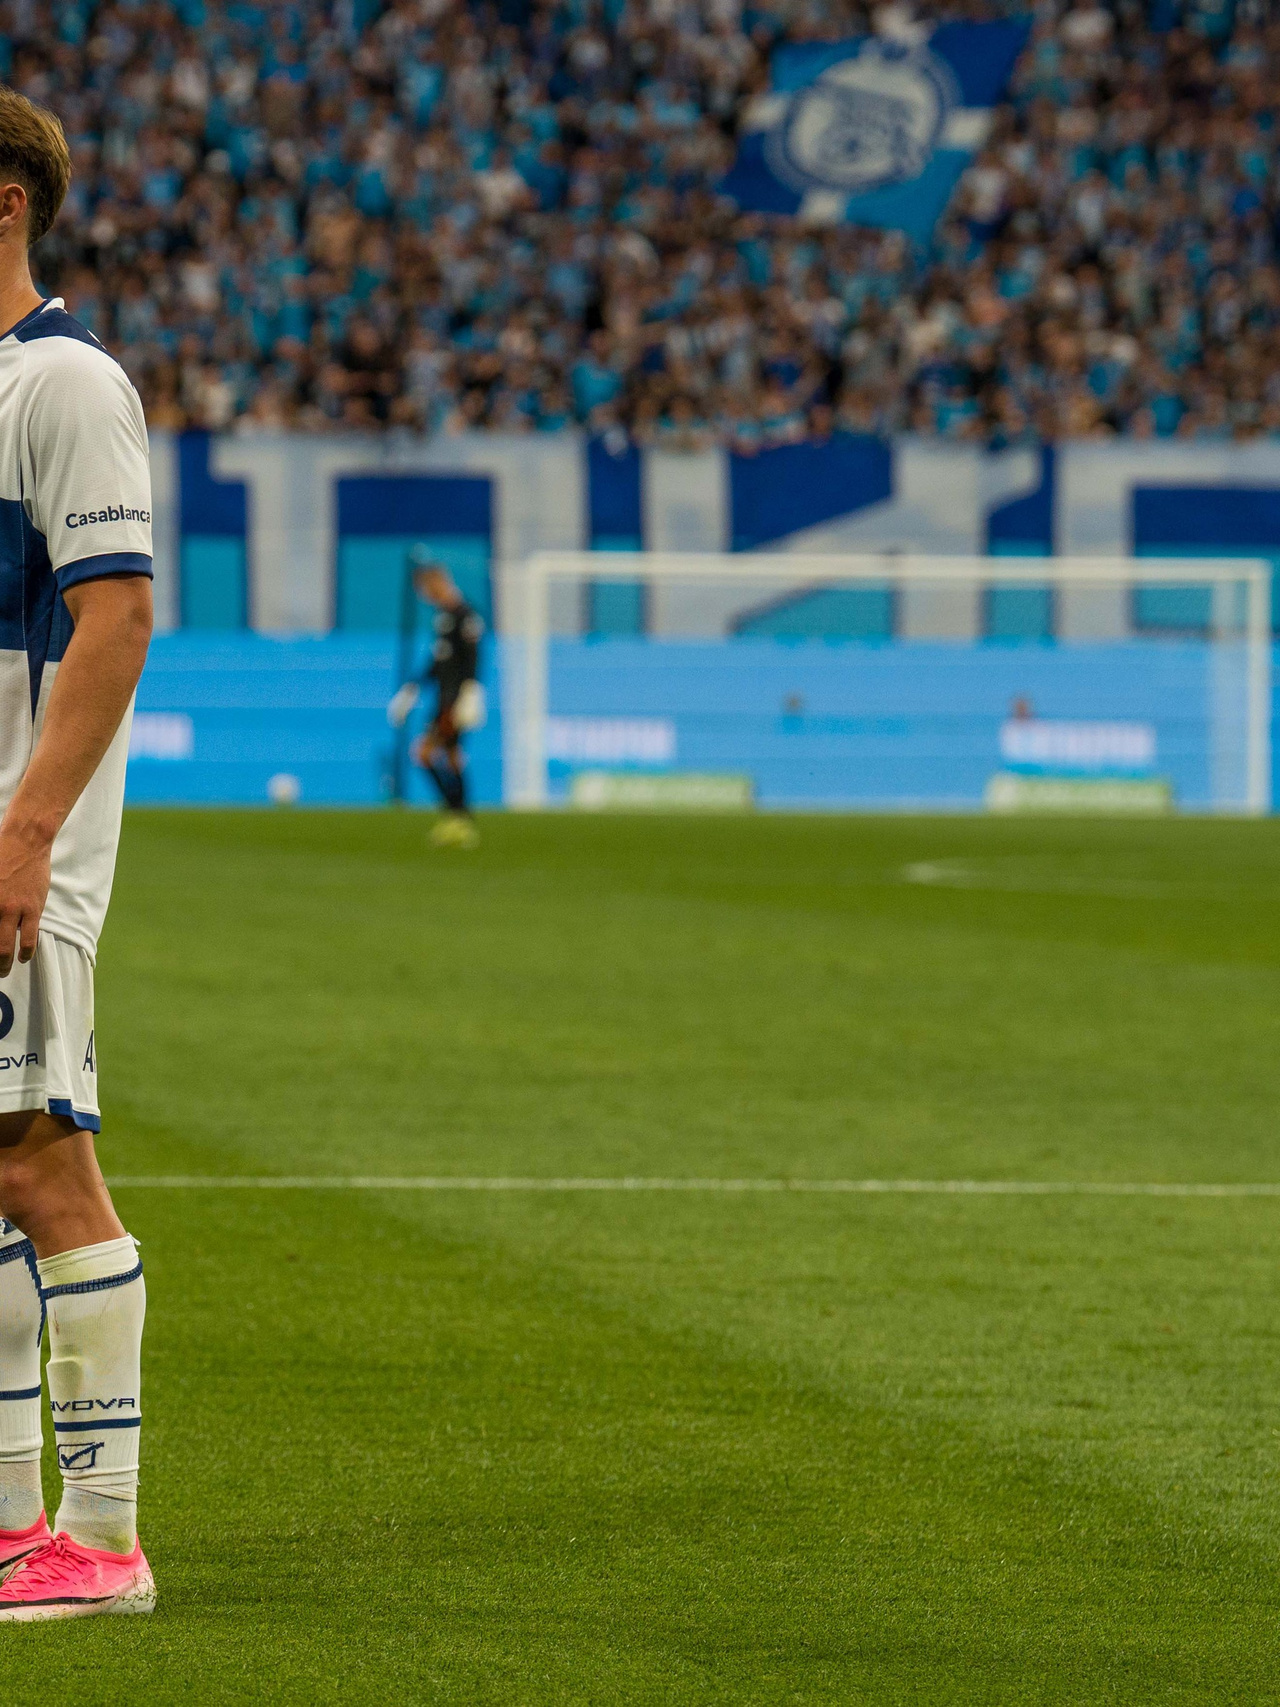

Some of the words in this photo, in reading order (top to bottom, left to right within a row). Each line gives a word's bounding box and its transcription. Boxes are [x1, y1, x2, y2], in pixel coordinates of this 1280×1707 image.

[65, 504, 151, 529] Casablanca
[82, 1029, 96, 1073] A
[51, 1397, 135, 1412] IVOVA
